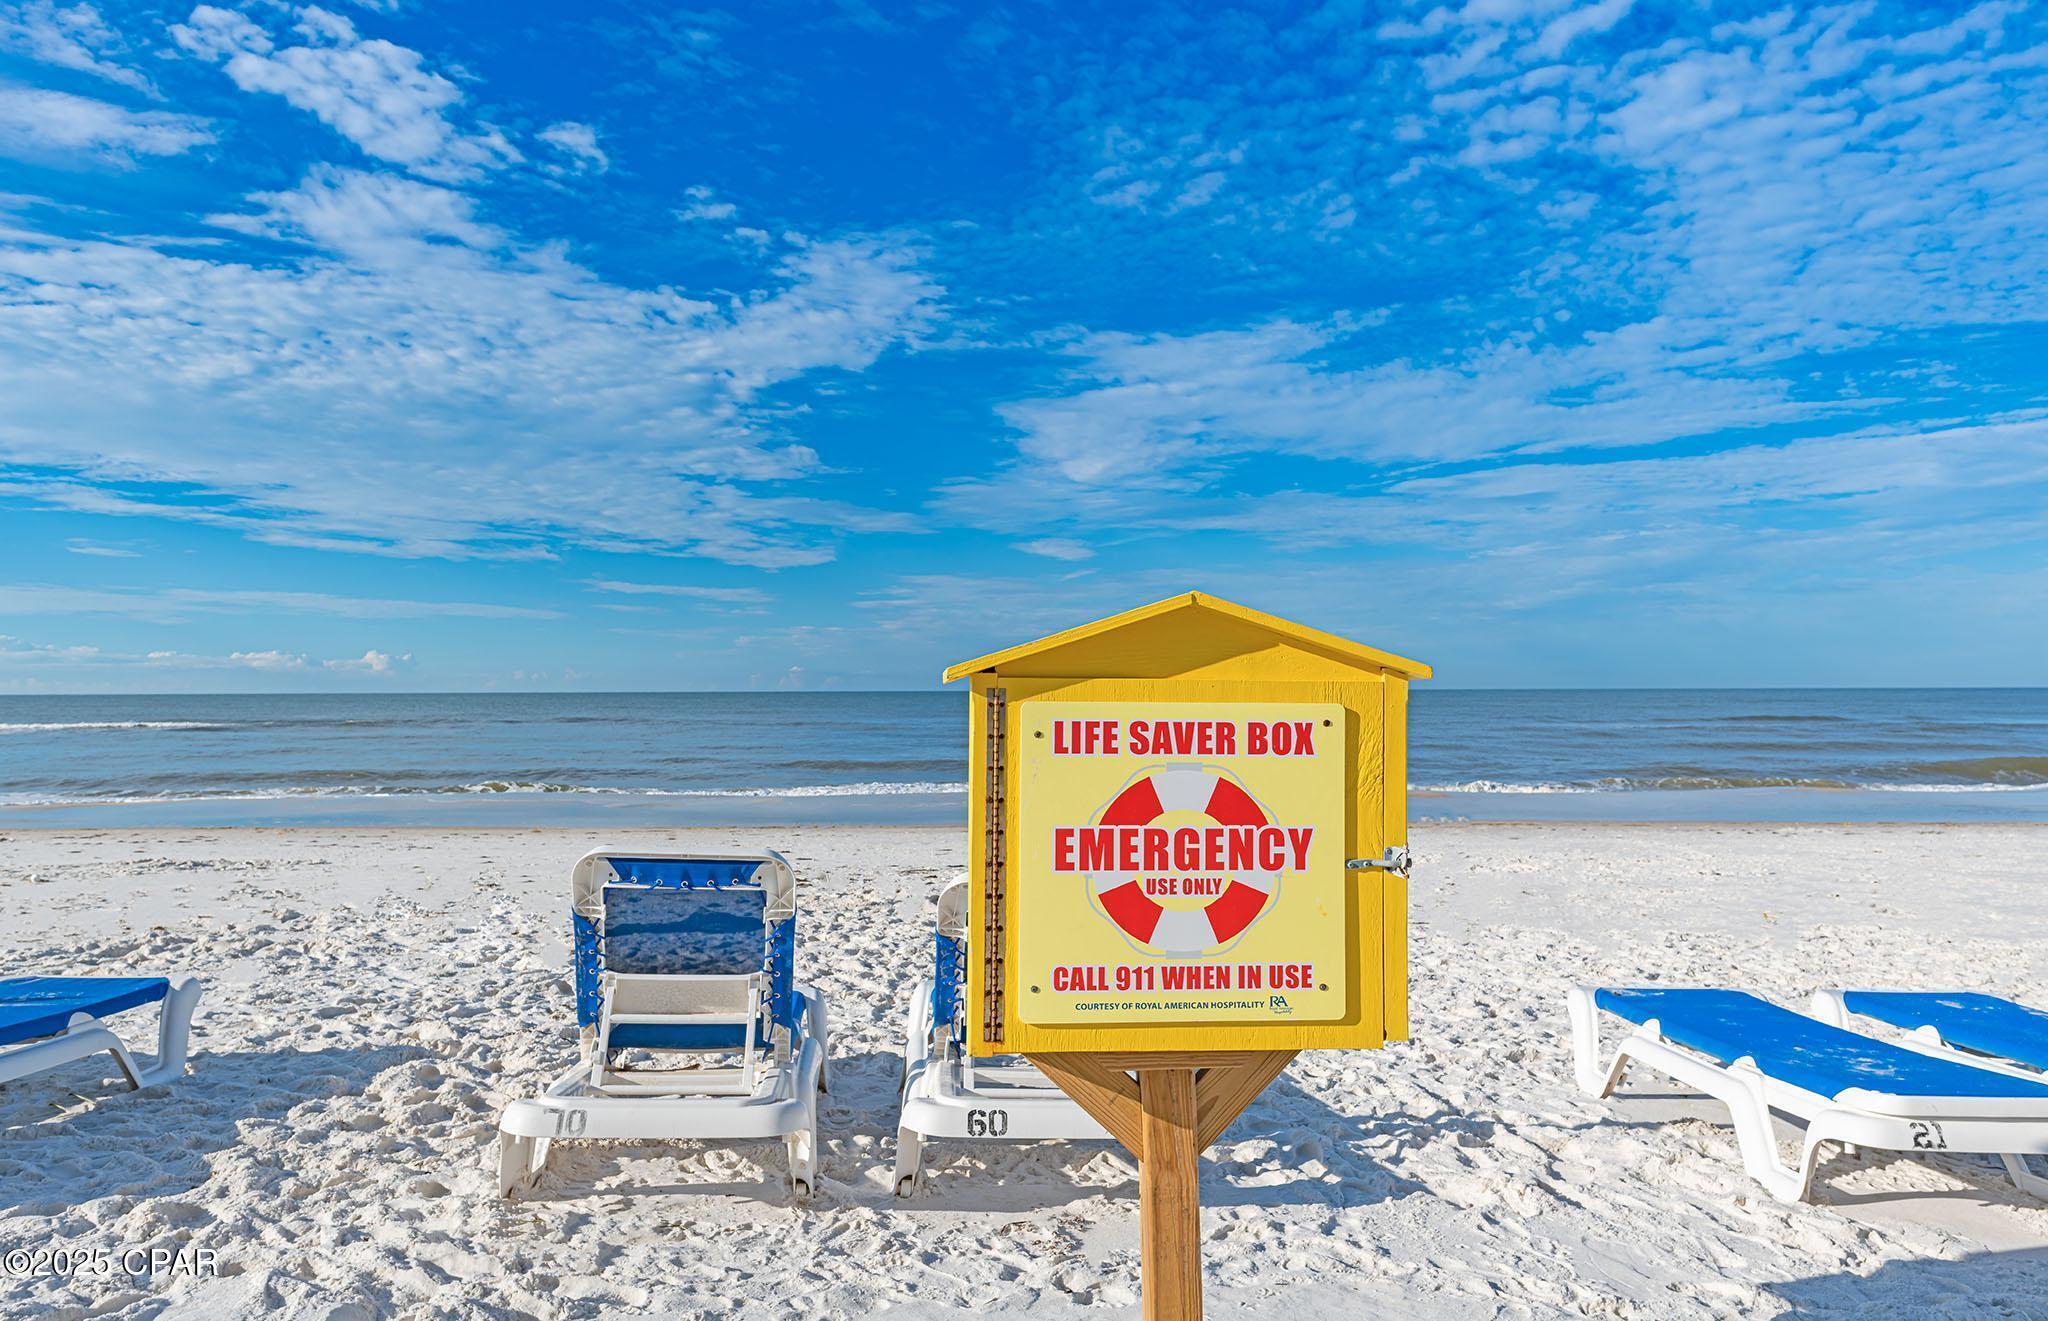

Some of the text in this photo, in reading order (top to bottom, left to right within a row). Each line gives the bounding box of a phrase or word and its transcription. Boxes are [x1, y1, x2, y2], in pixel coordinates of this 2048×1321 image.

[1054, 720, 1315, 756] LIFE SAVER BOX
[1054, 827, 1314, 872] EMERGENCY
[1145, 877, 1223, 896] USE ONLY
[1053, 964, 1313, 991] CALL 911 WHEN IN USE
[1075, 1000, 1265, 1011] COURTESY OF ROYAL AMERICAN HOSPITALITY
[1269, 995, 1289, 1007] RA
[967, 1109, 1008, 1137] 60
[1909, 1120, 1947, 1149] 21
